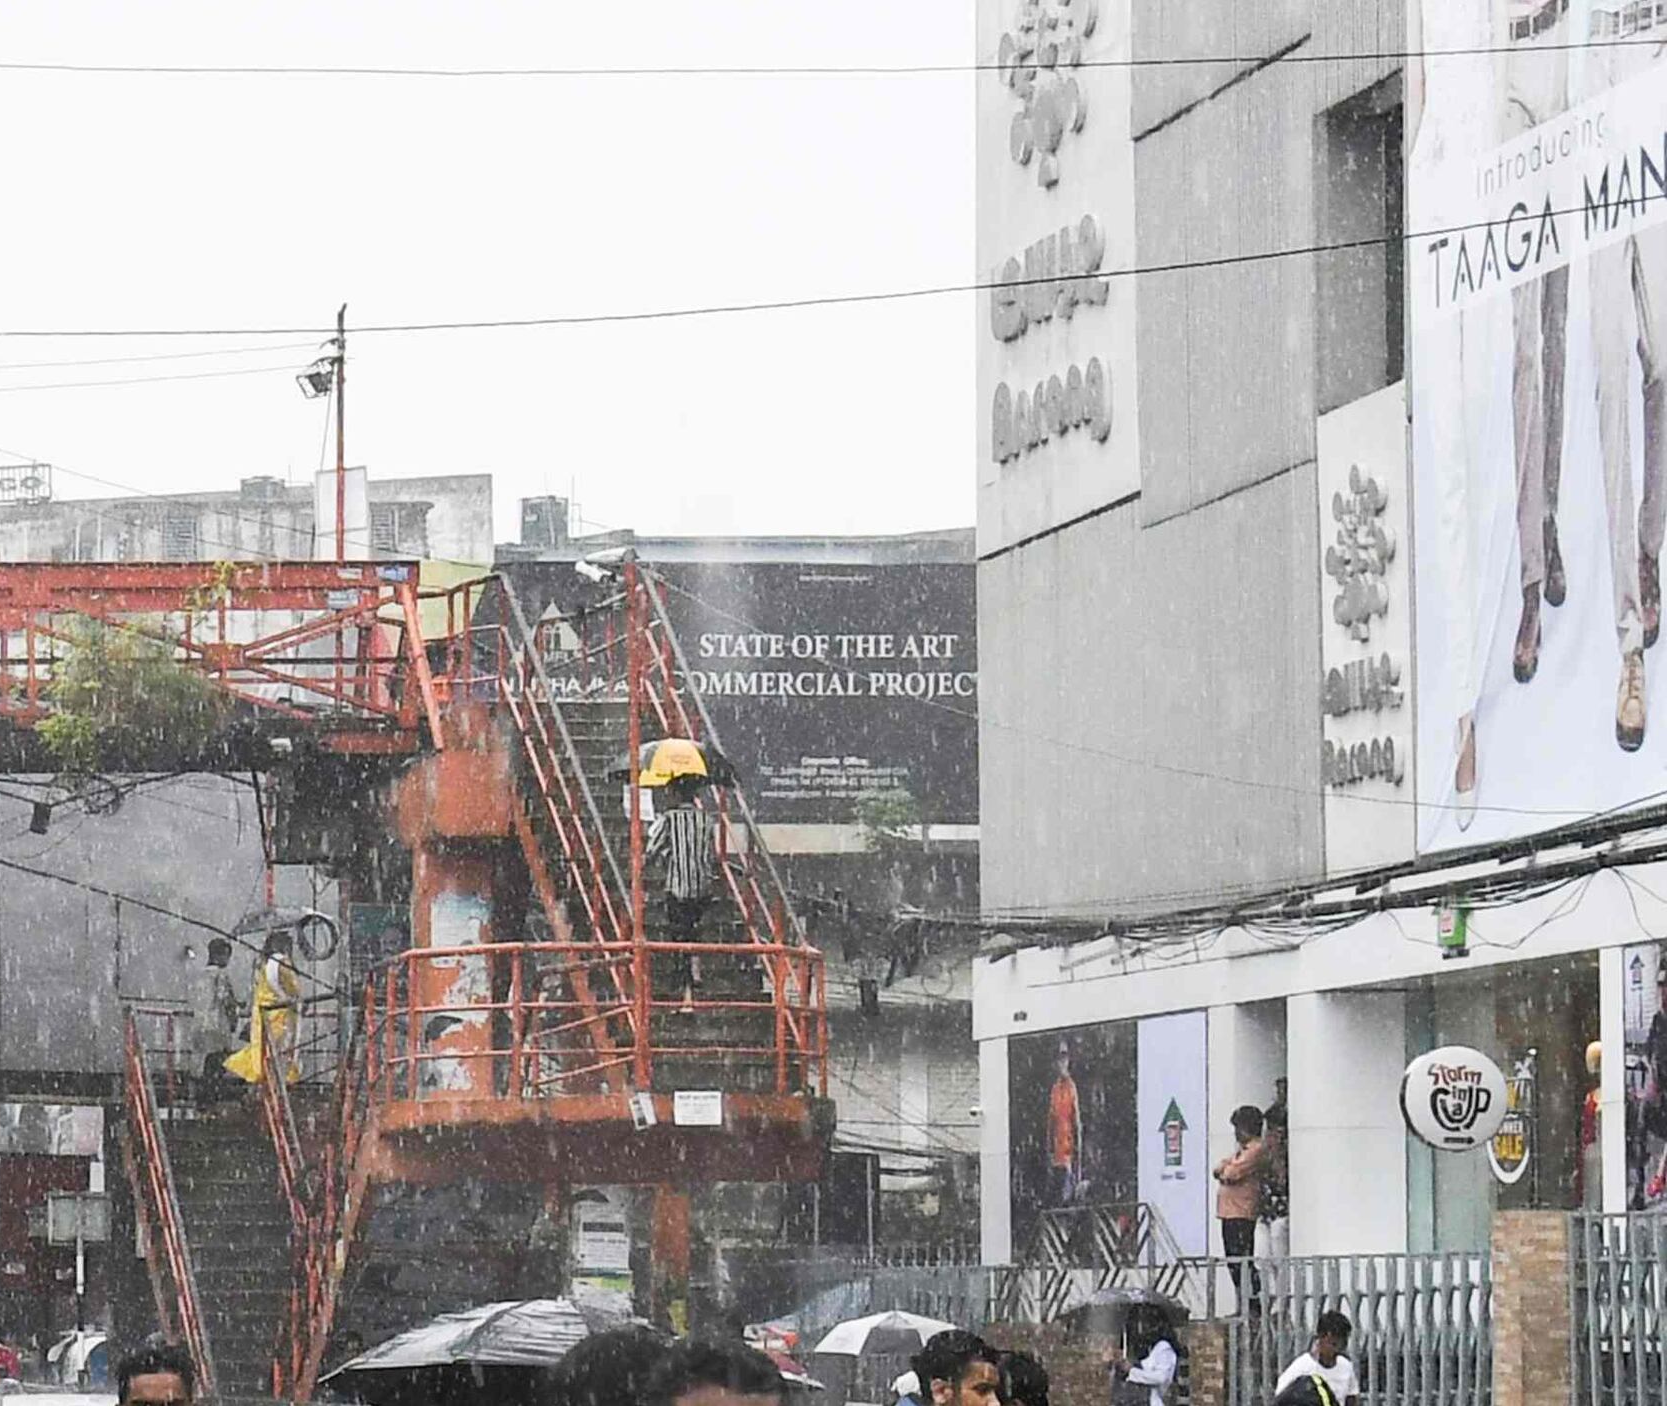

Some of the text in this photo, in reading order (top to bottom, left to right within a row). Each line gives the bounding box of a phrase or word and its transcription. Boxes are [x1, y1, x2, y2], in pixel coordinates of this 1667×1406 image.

[1428, 132, 1667, 308] TAAGA MAN
[699, 633, 959, 659] STATE OF THE ART
[1428, 1063, 1482, 1086] Storm
[1452, 1086, 1467, 1101] in
[1452, 1103, 1463, 1117] a
